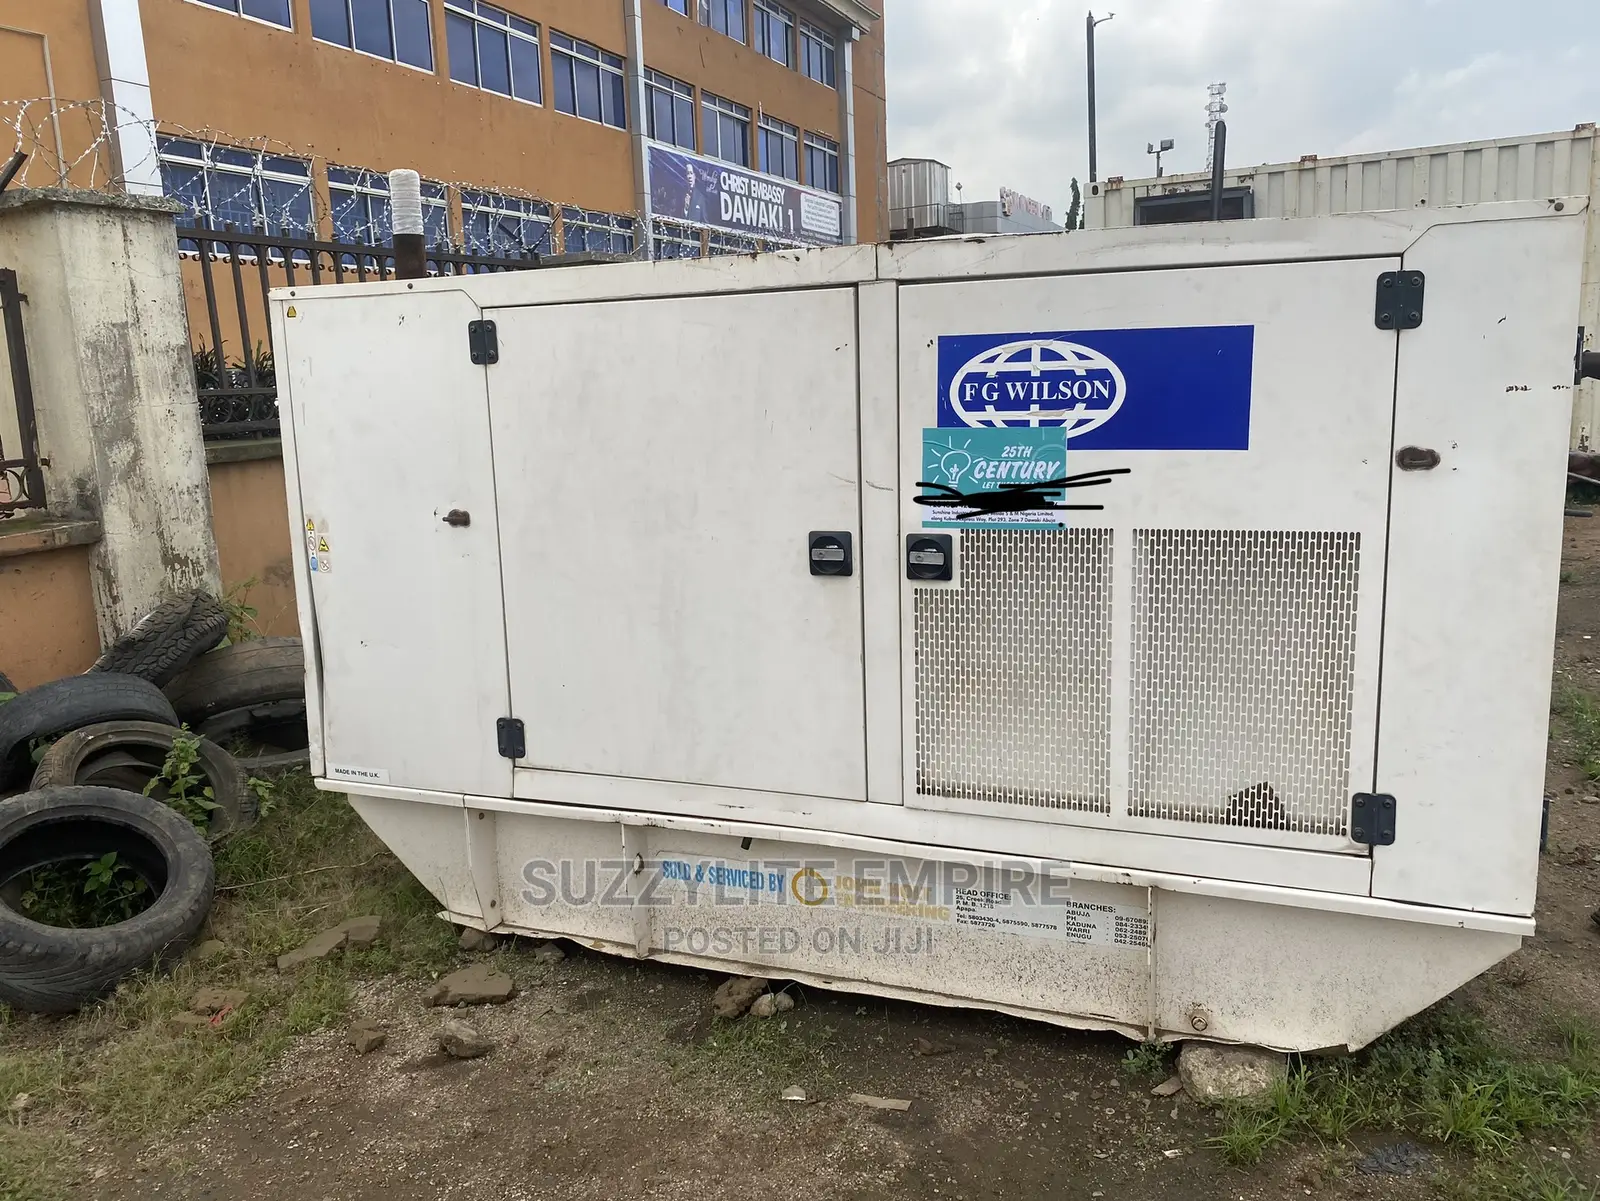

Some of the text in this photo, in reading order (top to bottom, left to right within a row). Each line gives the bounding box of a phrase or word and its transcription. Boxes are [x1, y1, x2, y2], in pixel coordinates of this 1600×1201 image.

[720, 171, 749, 196] CHRIST
[750, 179, 785, 205] EMBASSY
[787, 208, 795, 235] 1
[1005, 379, 1111, 401] WILSON
[1001, 445, 1033, 458] 25TH
[974, 460, 1060, 480] CENTURY
[982, 481, 996, 489] LET
[662, 860, 785, 893] SOLD & SERVICED BY
[955, 887, 1012, 901] HEAD OFFICE:
[1066, 900, 1117, 914] BRANCHES:
[1066, 909, 1091, 918] ABUJA
[1066, 920, 1097, 930] KADUNA
[1066, 926, 1091, 934] WARRI
[1066, 932, 1092, 940] ENUGU
